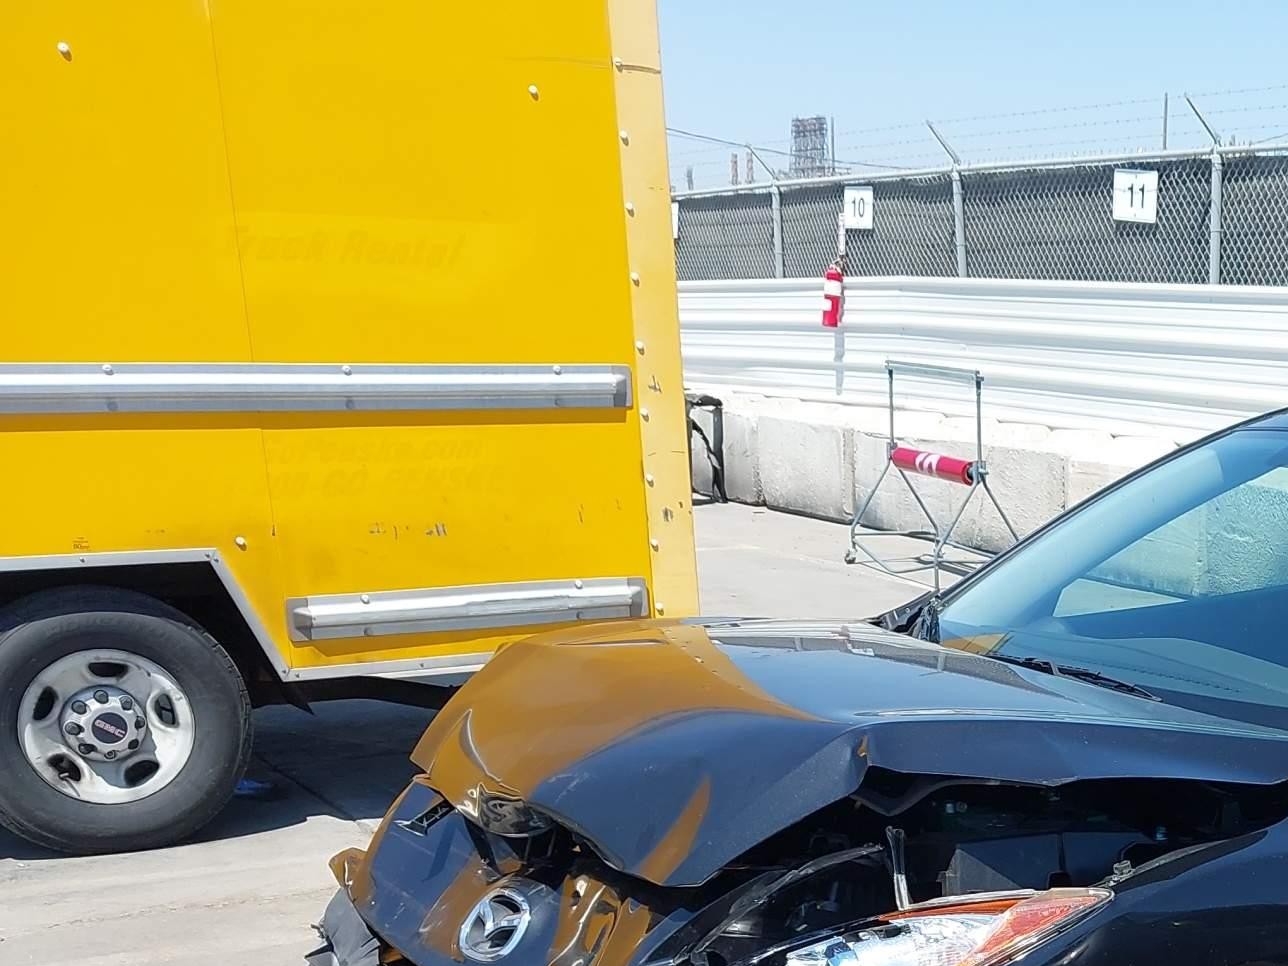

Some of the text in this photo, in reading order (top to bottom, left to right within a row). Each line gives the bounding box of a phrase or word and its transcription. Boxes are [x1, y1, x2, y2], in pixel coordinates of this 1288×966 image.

[850, 196, 865, 218] 10
[1127, 183, 1145, 209] 11
[94, 719, 126, 738] GMC
